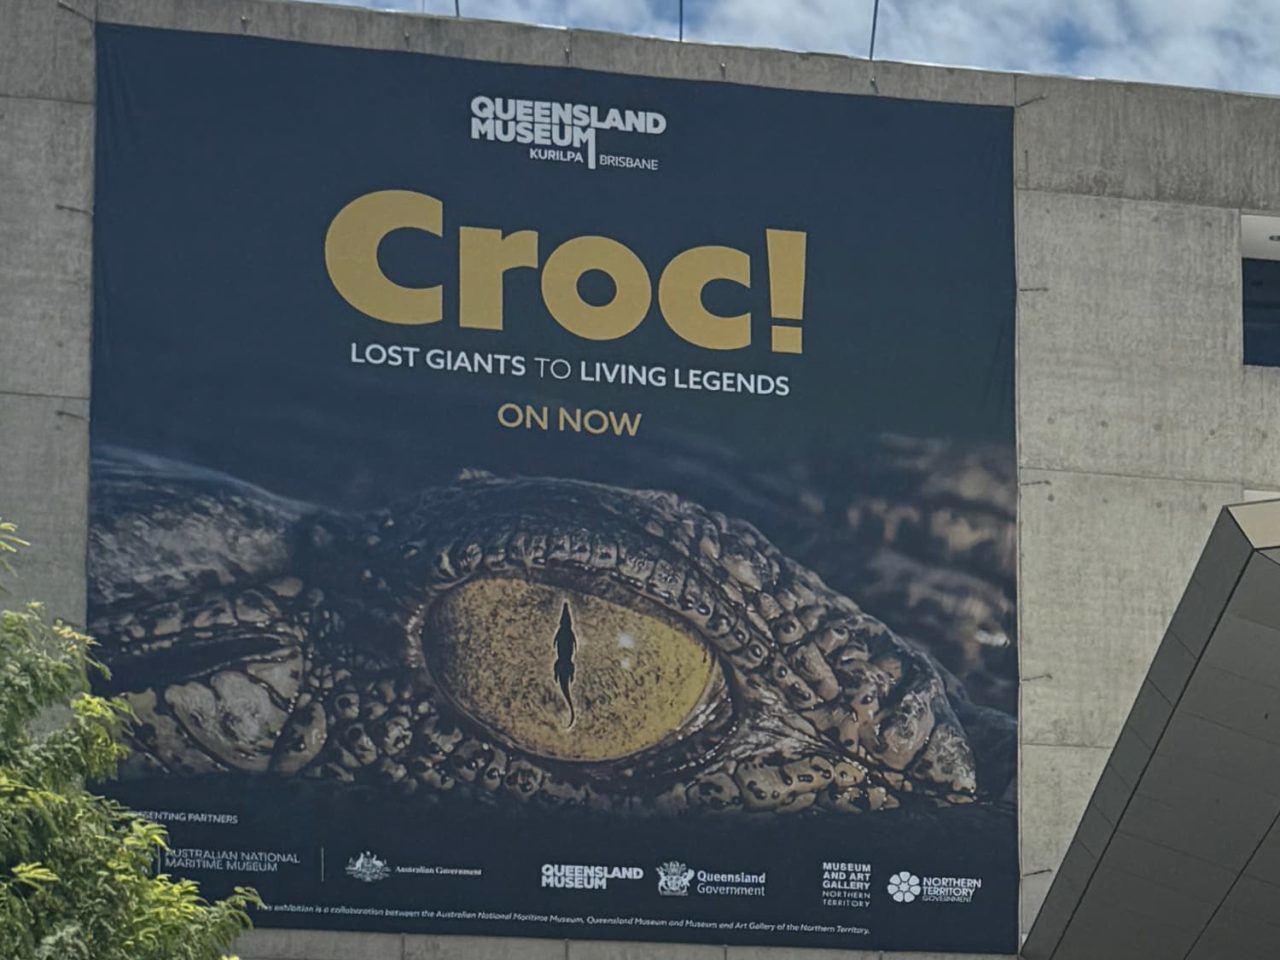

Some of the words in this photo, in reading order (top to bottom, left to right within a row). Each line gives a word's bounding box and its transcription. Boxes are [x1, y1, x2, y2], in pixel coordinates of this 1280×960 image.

[470, 96, 666, 134] QUEENSLAND
[470, 118, 596, 168] MUSEUM
[530, 148, 584, 163] KURILPA
[599, 154, 659, 171] BRISBANE
[325, 189, 807, 354] Croc!
[350, 342, 419, 368] LOST
[426, 348, 526, 376] GIANTS
[534, 357, 572, 380] TO
[580, 361, 666, 388] LIVING
[674, 368, 790, 397] LEGENDS
[498, 403, 548, 431] ON
[559, 408, 642, 437] NOW
[188, 813, 238, 824] PARTNERS
[165, 849, 238, 862] AUSTRALIAN
[241, 852, 300, 864] NATIONAL
[165, 858, 223, 870] MARITIME
[227, 860, 277, 872] MUSEUM
[395, 866, 435, 874] Australian
[436, 867, 482, 876] Government
[541, 864, 644, 879] QUEENSLAND
[822, 862, 871, 872] MUSEUM
[541, 876, 606, 889] MUSEUM
[697, 870, 766, 883] Queensland
[823, 872, 846, 880] AND
[849, 872, 871, 881] ART
[923, 877, 982, 888] NORTHERN
[697, 883, 765, 896] Government
[822, 881, 870, 890] GALLERY
[923, 886, 976, 897] TERRITORY
[822, 890, 871, 899] NORTHERN
[823, 899, 870, 908] TERRITORY
[436, 911, 476, 920] Australian
[478, 911, 512, 920] National
[513, 913, 548, 922] Maritime
[635, 918, 667, 926] Museum
[685, 920, 717, 929] Museum
[800, 925, 835, 933] Northern
